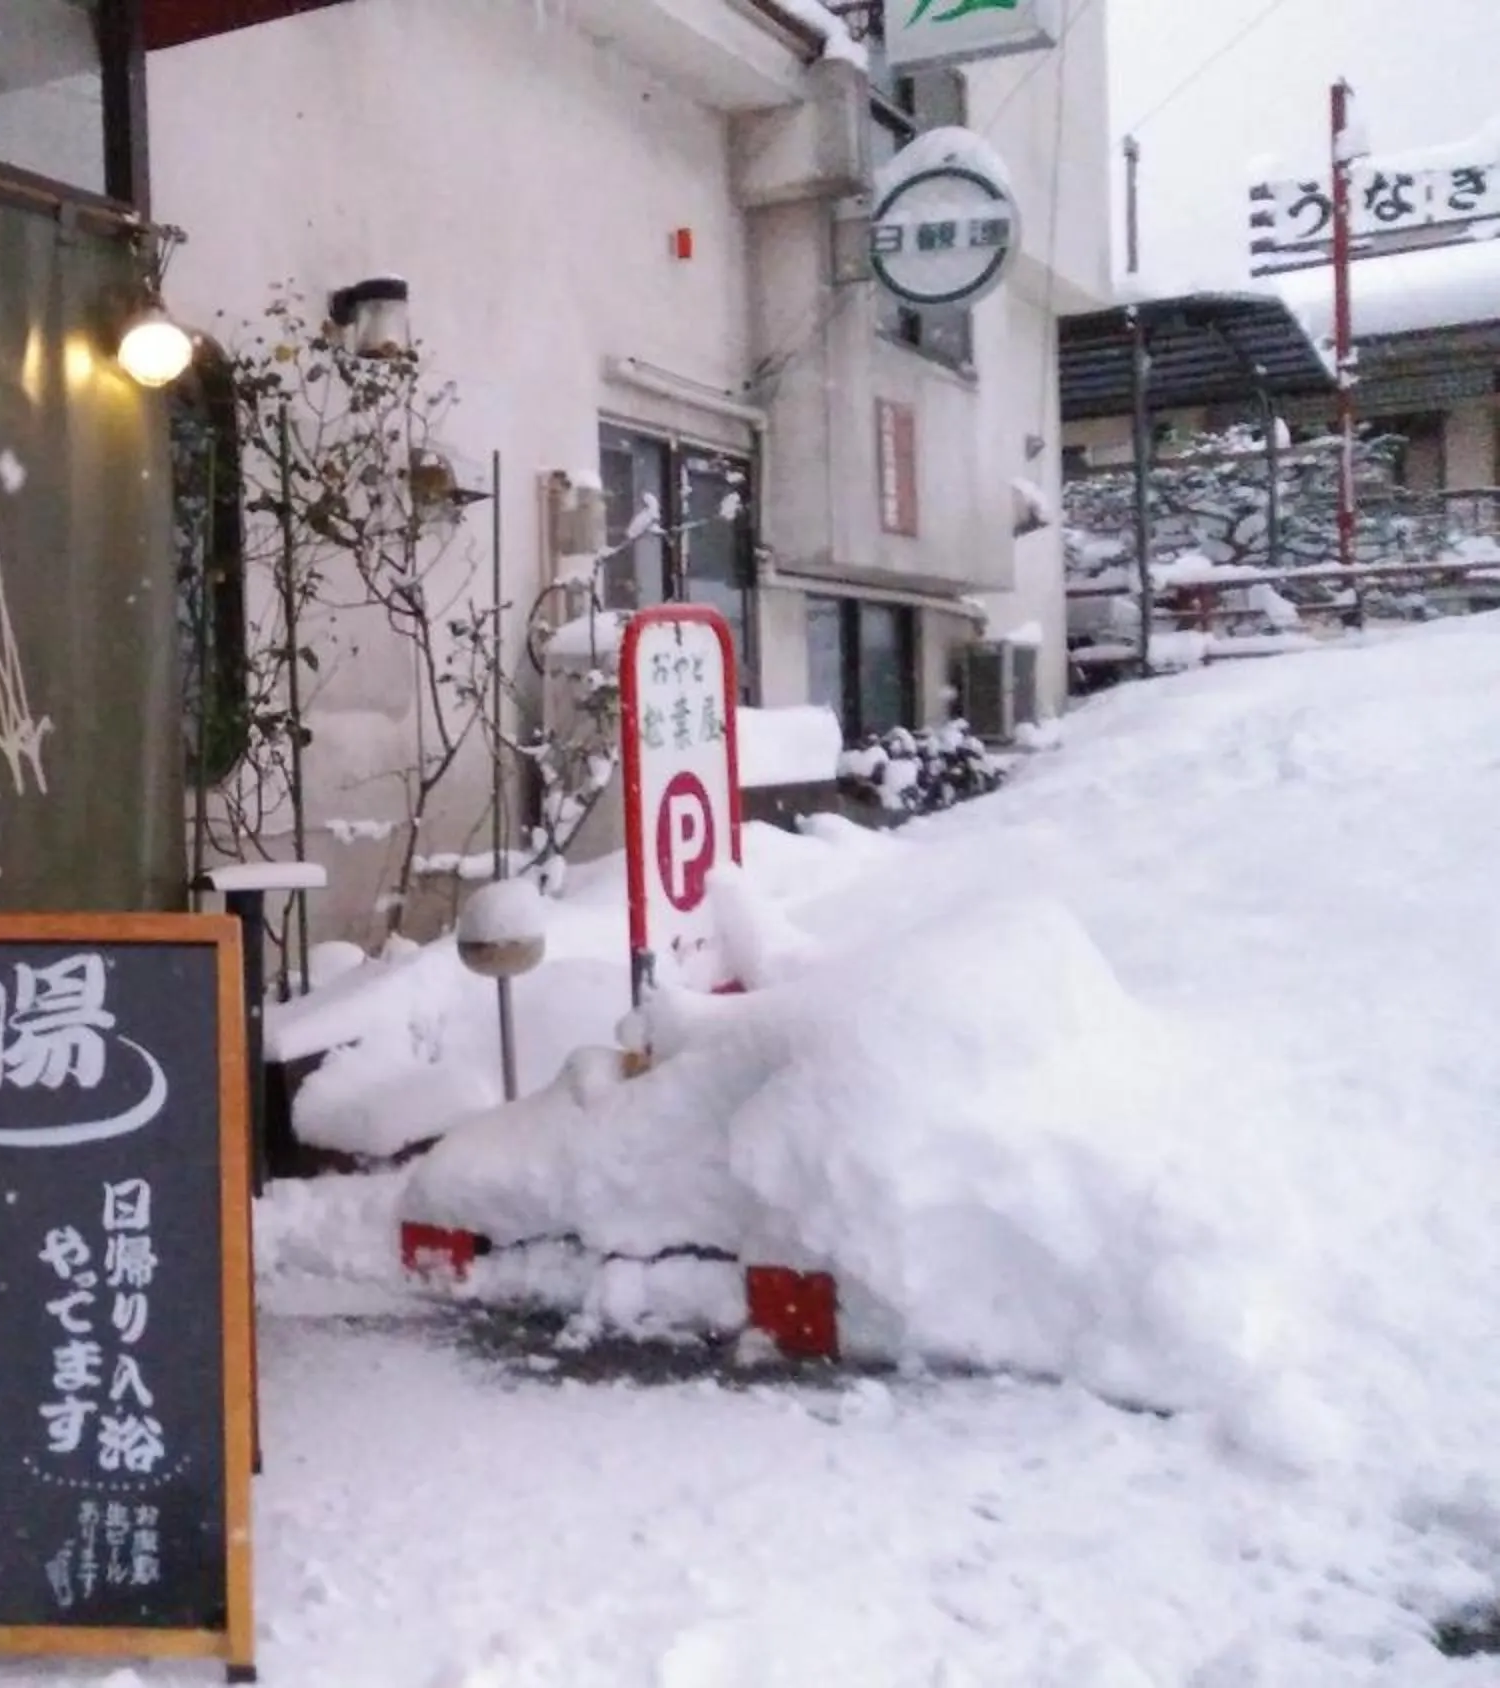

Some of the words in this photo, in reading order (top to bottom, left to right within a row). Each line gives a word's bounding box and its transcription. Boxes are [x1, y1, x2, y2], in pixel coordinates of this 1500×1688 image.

[669, 792, 706, 899] P
[37, 1223, 102, 1454] やってます
[98, 1177, 165, 1474] 日帰り入浴
